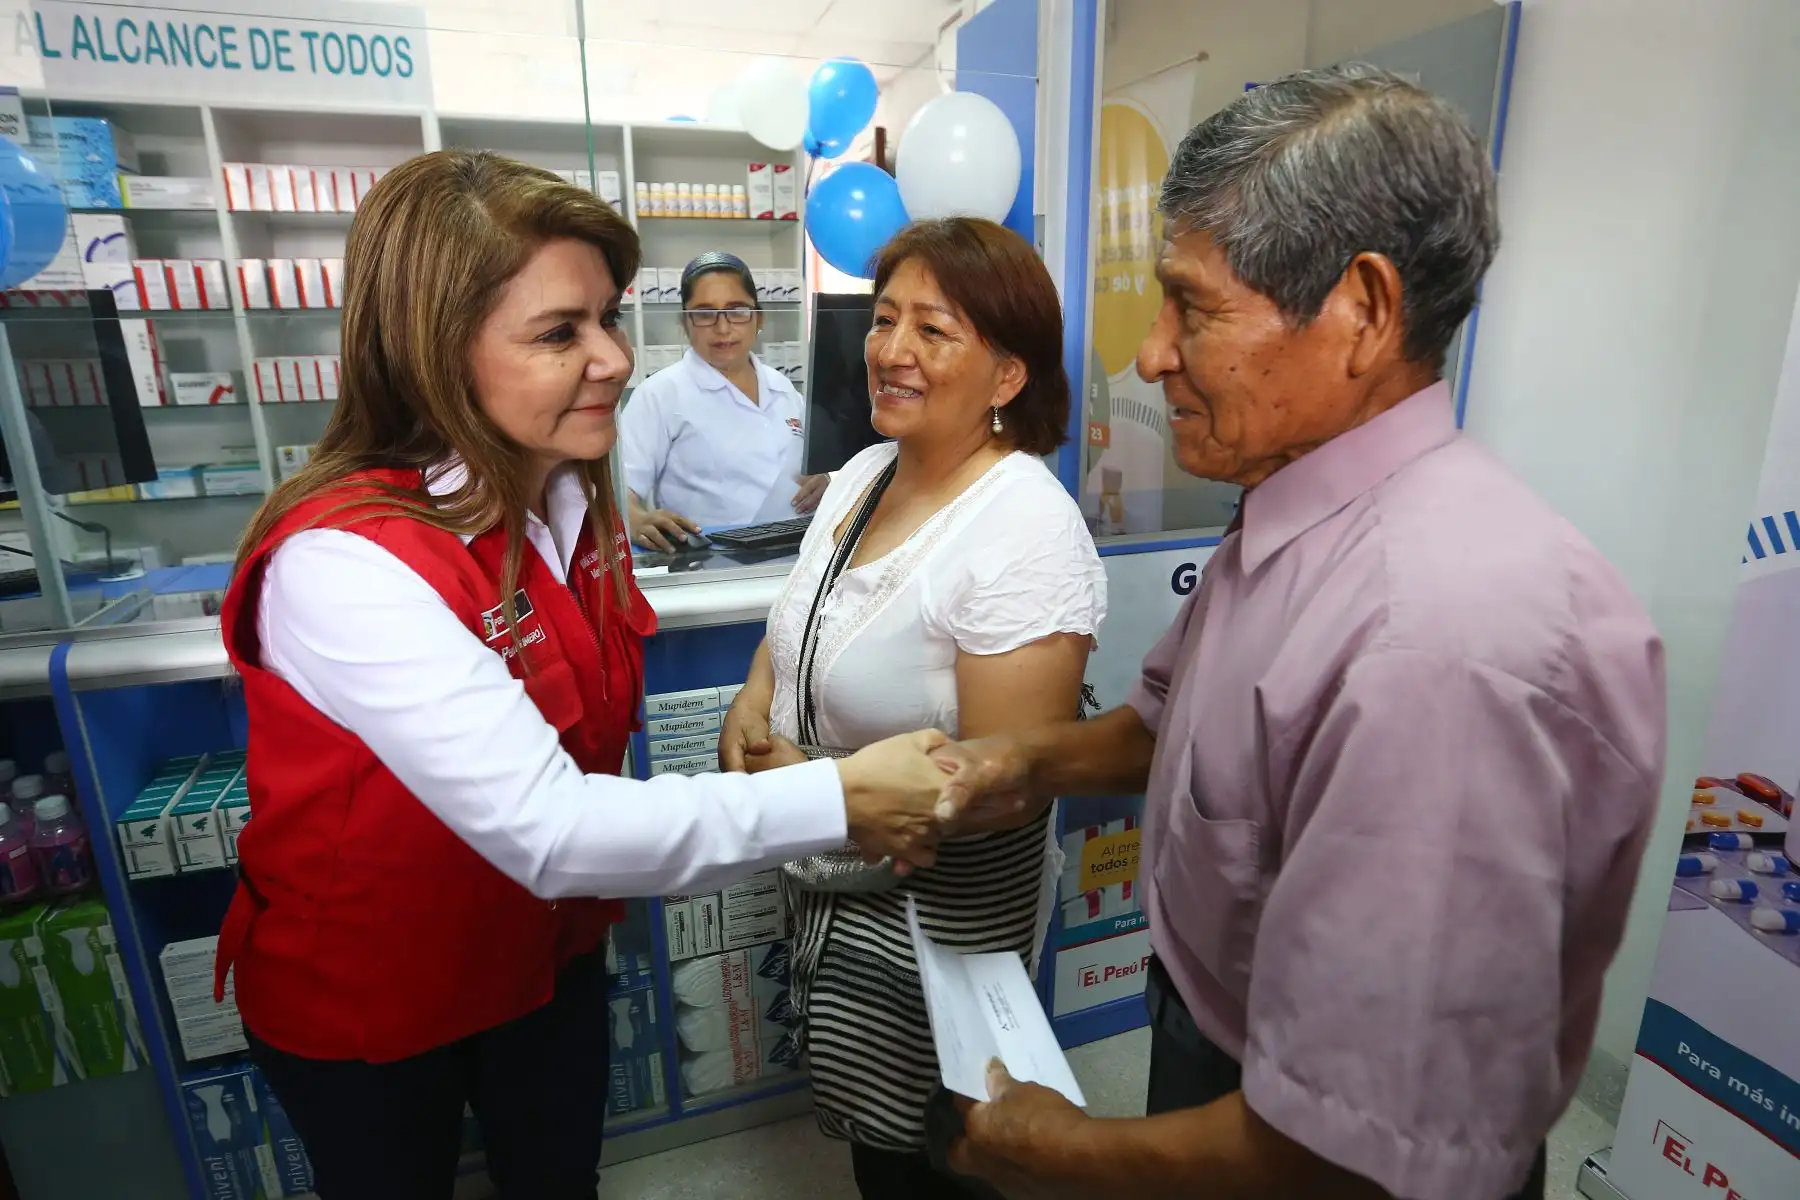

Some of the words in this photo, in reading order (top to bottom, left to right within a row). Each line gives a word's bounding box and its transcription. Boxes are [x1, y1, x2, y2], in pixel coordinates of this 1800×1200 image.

[15, 10, 62, 59] AL
[72, 14, 241, 70] ALCANCE
[248, 27, 296, 72] DE
[300, 30, 414, 78] TODOS
[1171, 562, 1204, 596] G
[658, 699, 704, 712] Mupiderm
[659, 720, 704, 733] Mupiderm
[660, 739, 705, 752] Mupiderm
[662, 760, 707, 772] Mupiderm
[1101, 844, 1115, 858] Al
[1091, 857, 1128, 874] todos
[1115, 918, 1137, 930] Para
[1083, 970, 1101, 988] EL
[1104, 961, 1138, 983] PERÚ
[1677, 1040, 1722, 1080] Para
[1727, 1075, 1774, 1112] más
[1662, 1135, 1696, 1177] EL
